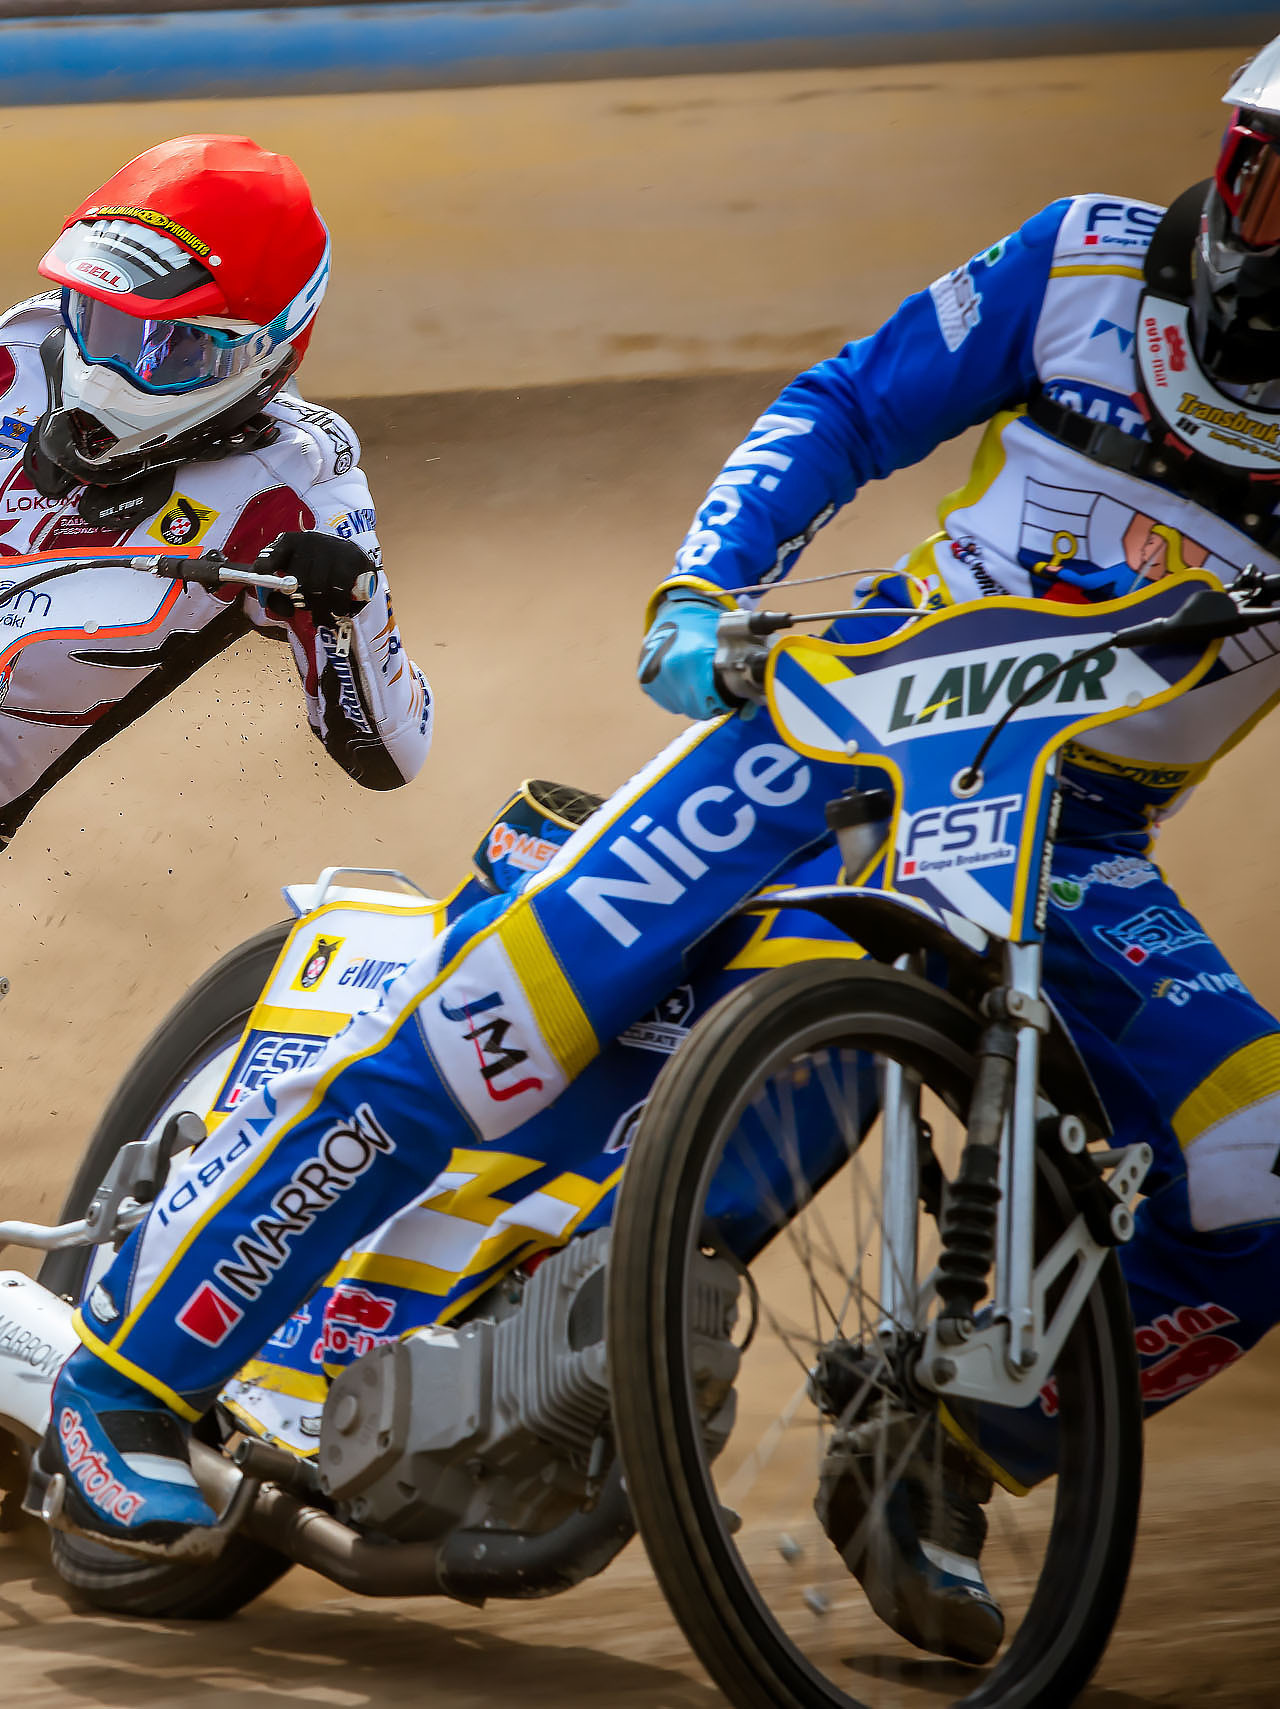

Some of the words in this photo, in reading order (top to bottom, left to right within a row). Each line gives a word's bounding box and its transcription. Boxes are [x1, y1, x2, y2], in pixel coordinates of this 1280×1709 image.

[76, 261, 121, 289] BELL
[670, 413, 816, 577] Nice
[887, 649, 1119, 734] LAVOR
[566, 742, 812, 949] Nice
[905, 799, 1018, 857] FST
[59, 1405, 146, 1528] daytona
